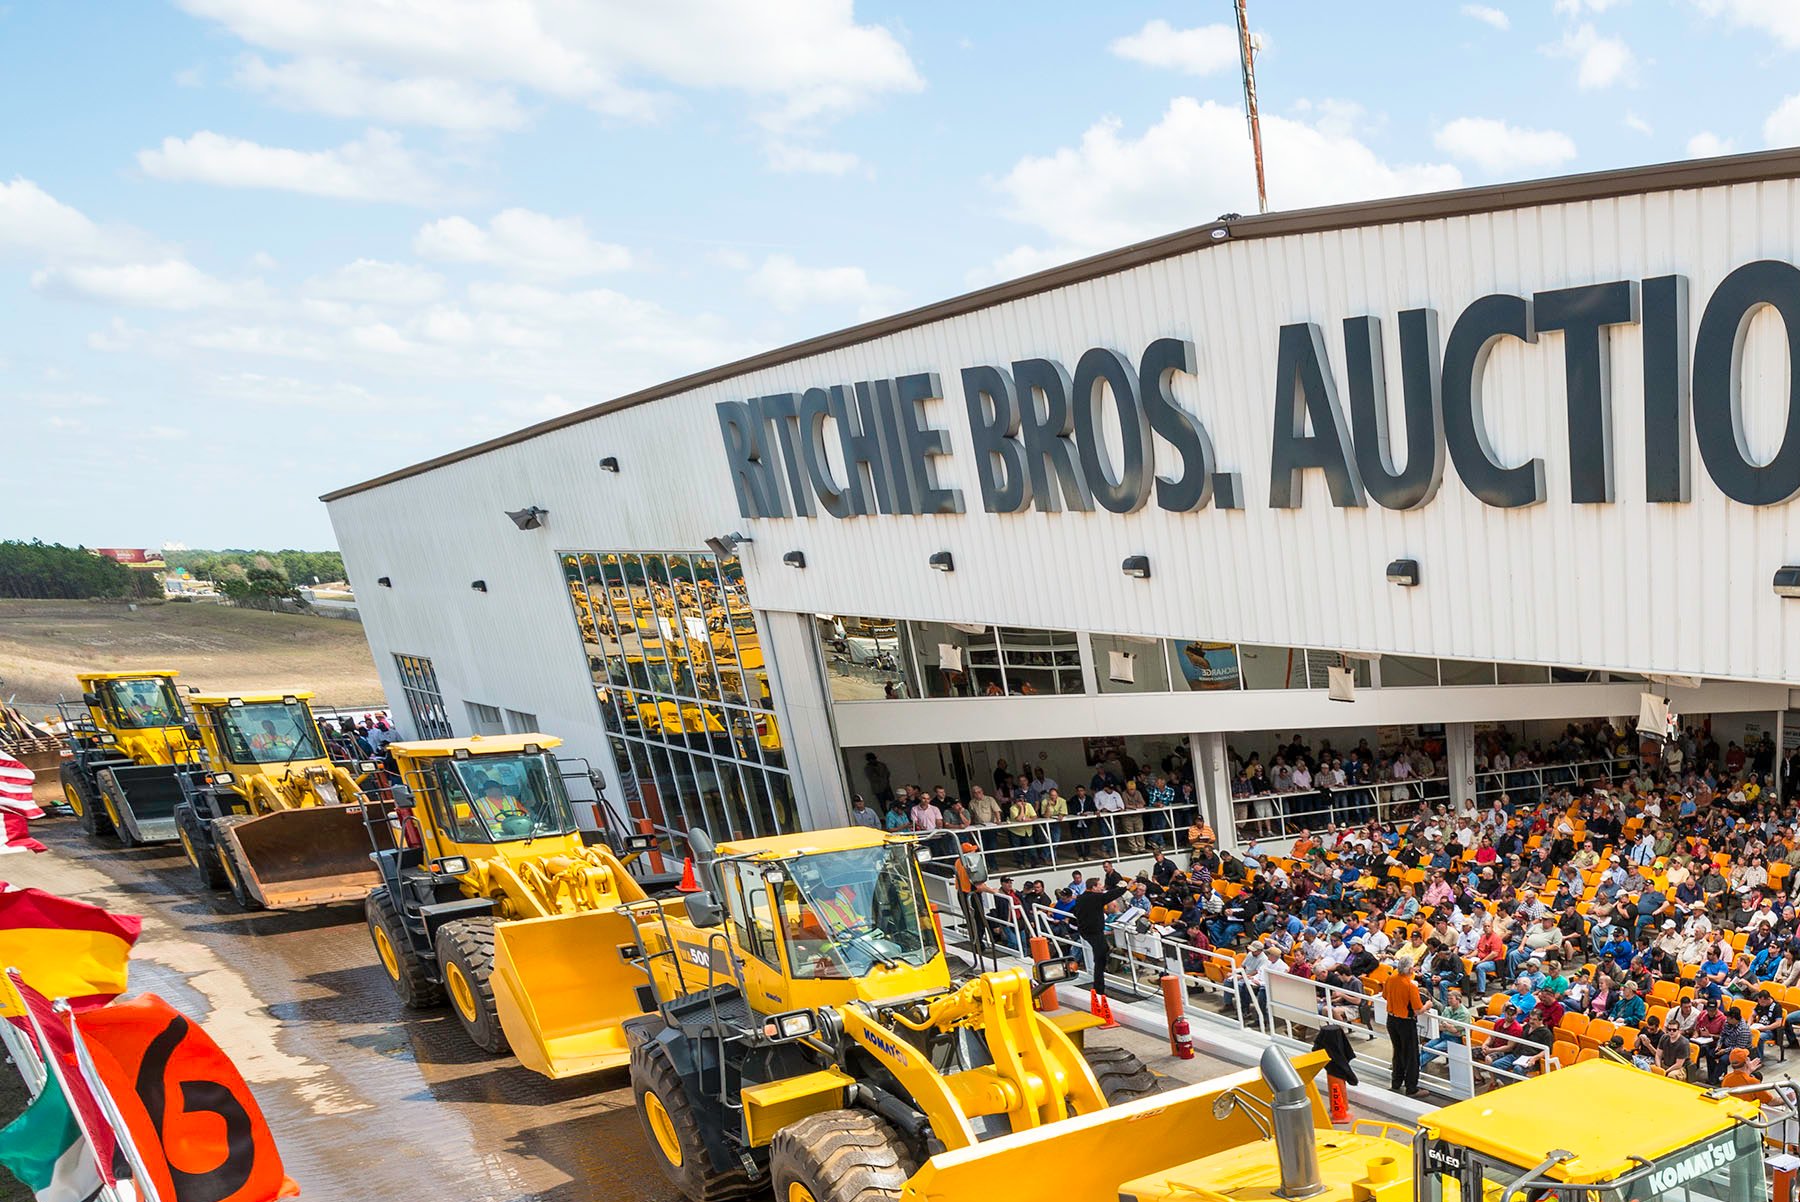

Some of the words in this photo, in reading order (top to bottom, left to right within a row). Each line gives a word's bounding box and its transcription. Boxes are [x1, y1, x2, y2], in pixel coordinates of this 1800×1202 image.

[715, 372, 966, 519] RITCHIE
[960, 338, 1244, 514] BROS.
[863, 1027, 909, 1068] KOMATSU
[1332, 1088, 1340, 1111] SOLD
[1428, 1148, 1460, 1169] GALEO
[1648, 1140, 1738, 1195] KOMATSU
